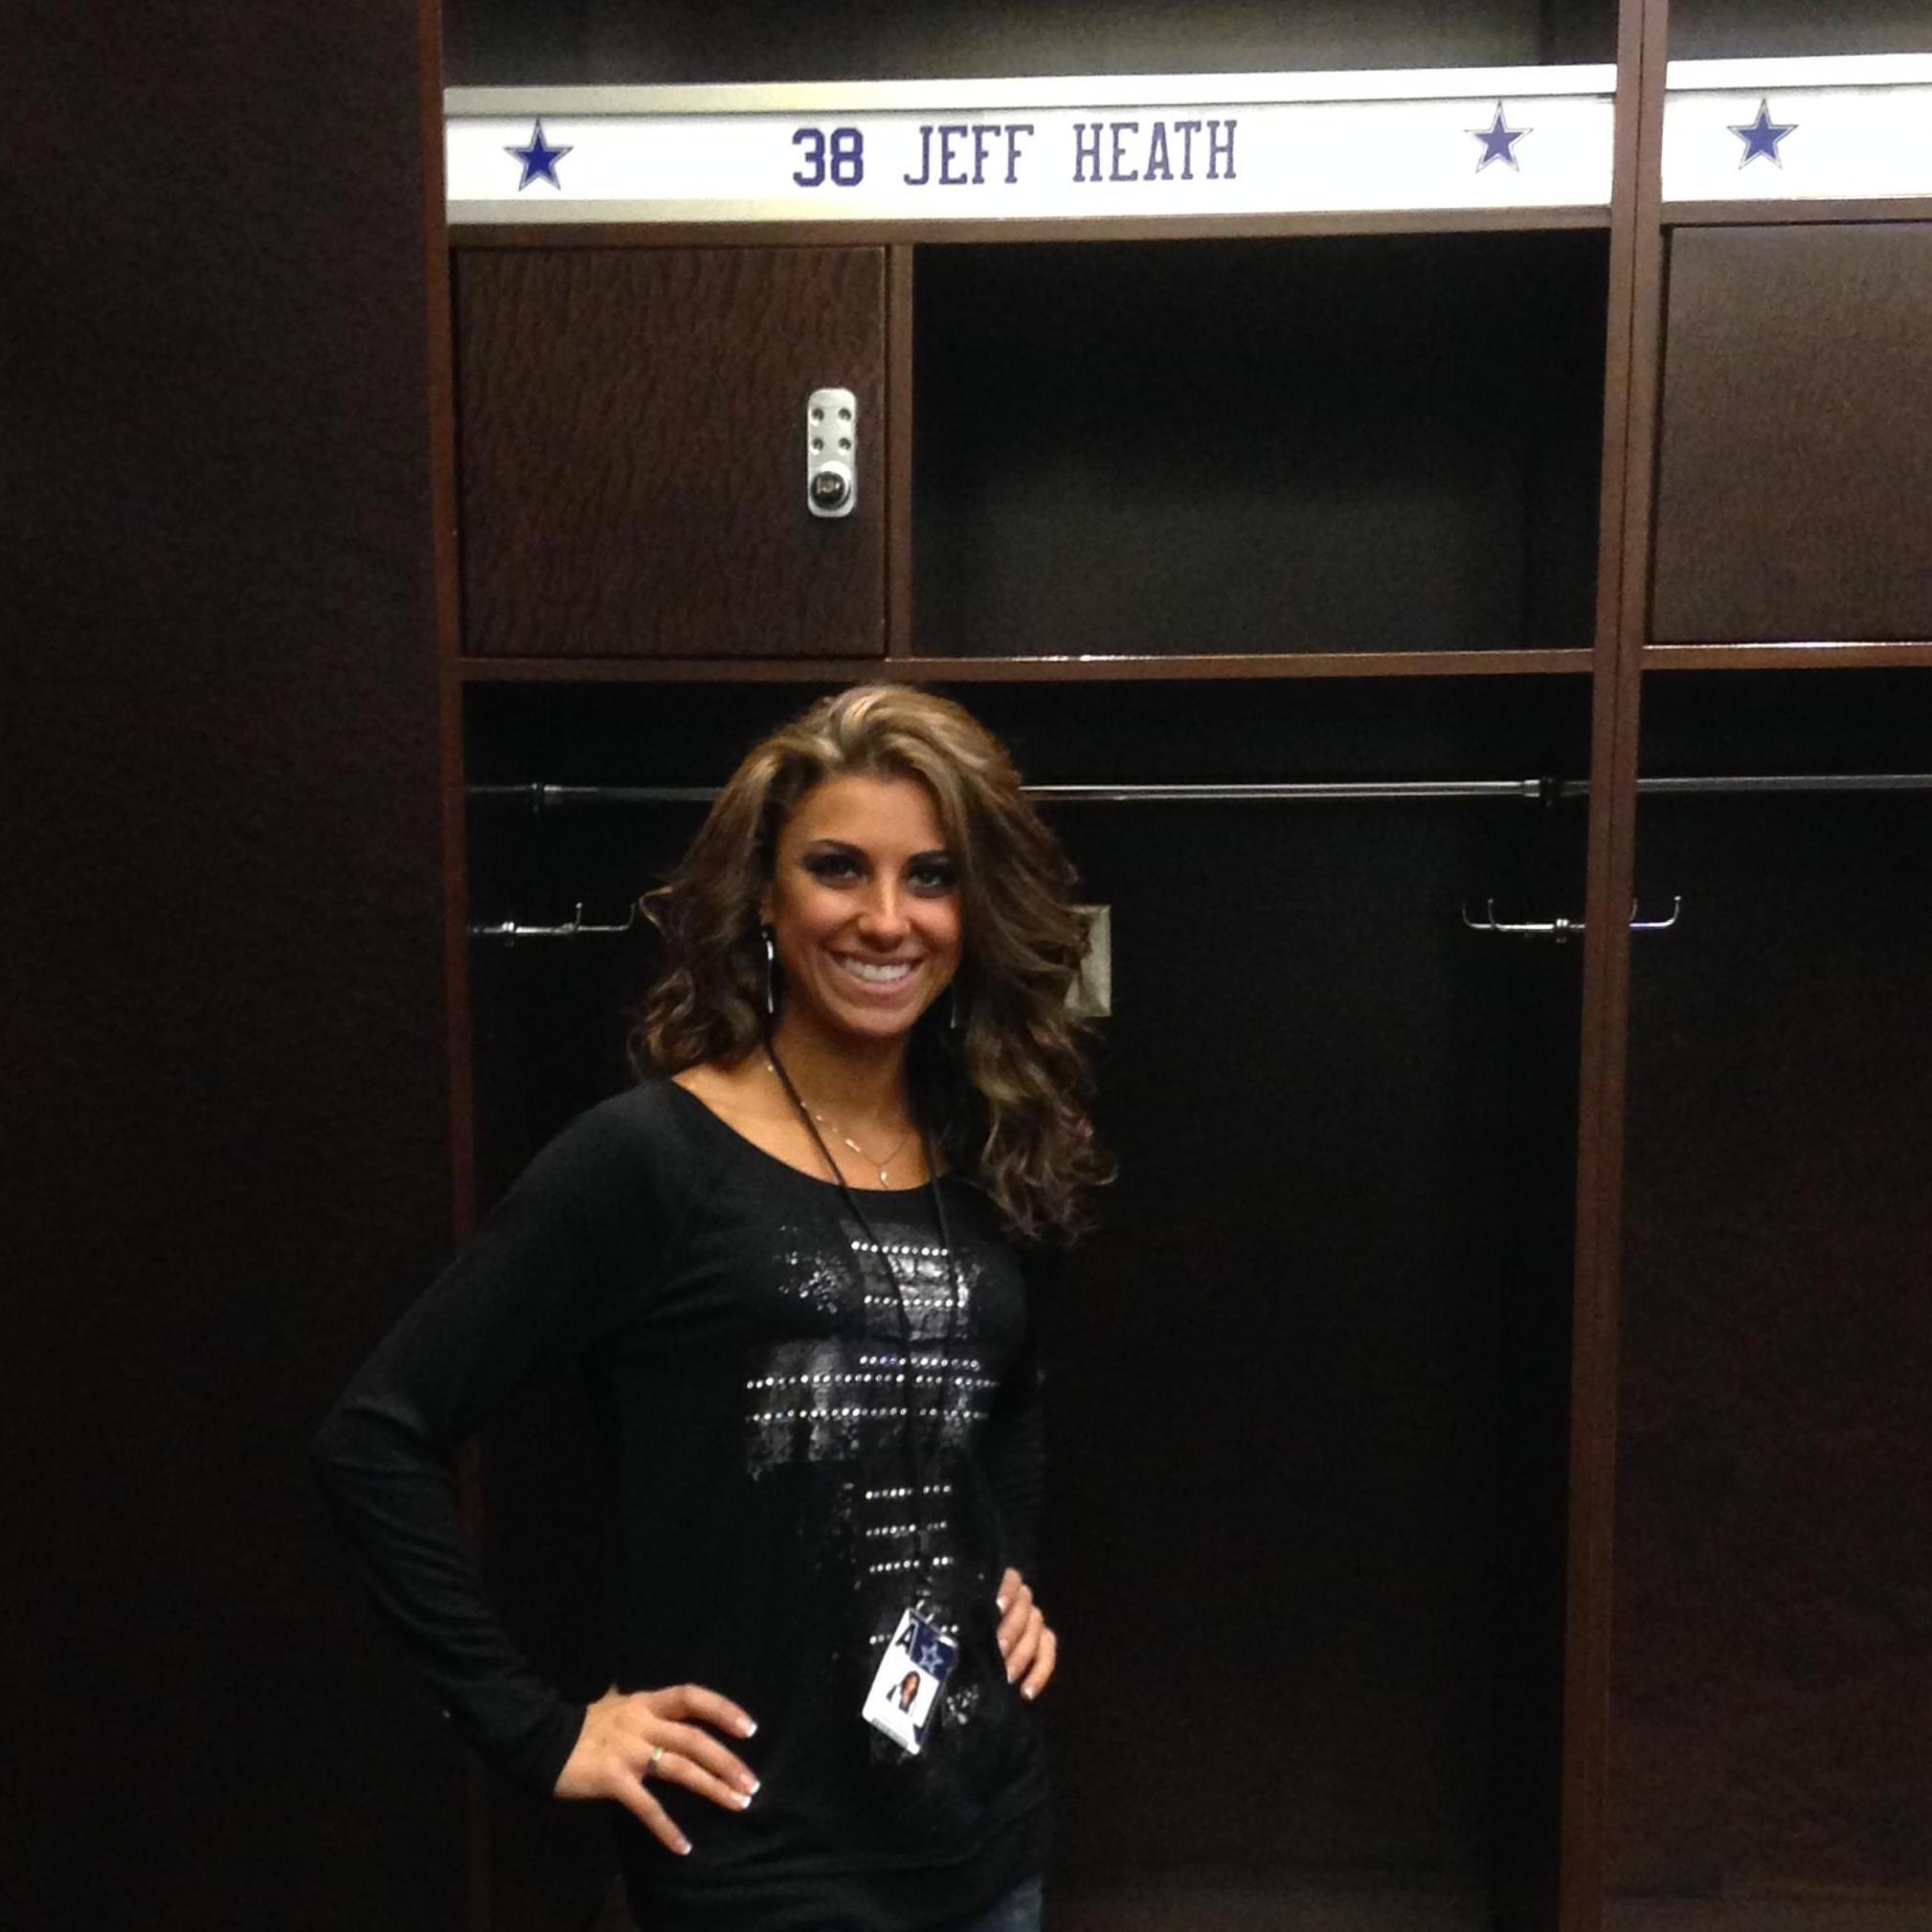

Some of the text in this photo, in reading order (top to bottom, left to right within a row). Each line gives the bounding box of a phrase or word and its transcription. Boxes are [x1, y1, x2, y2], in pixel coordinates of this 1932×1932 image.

[792, 120, 1237, 187] 38 JEFF HEATH
